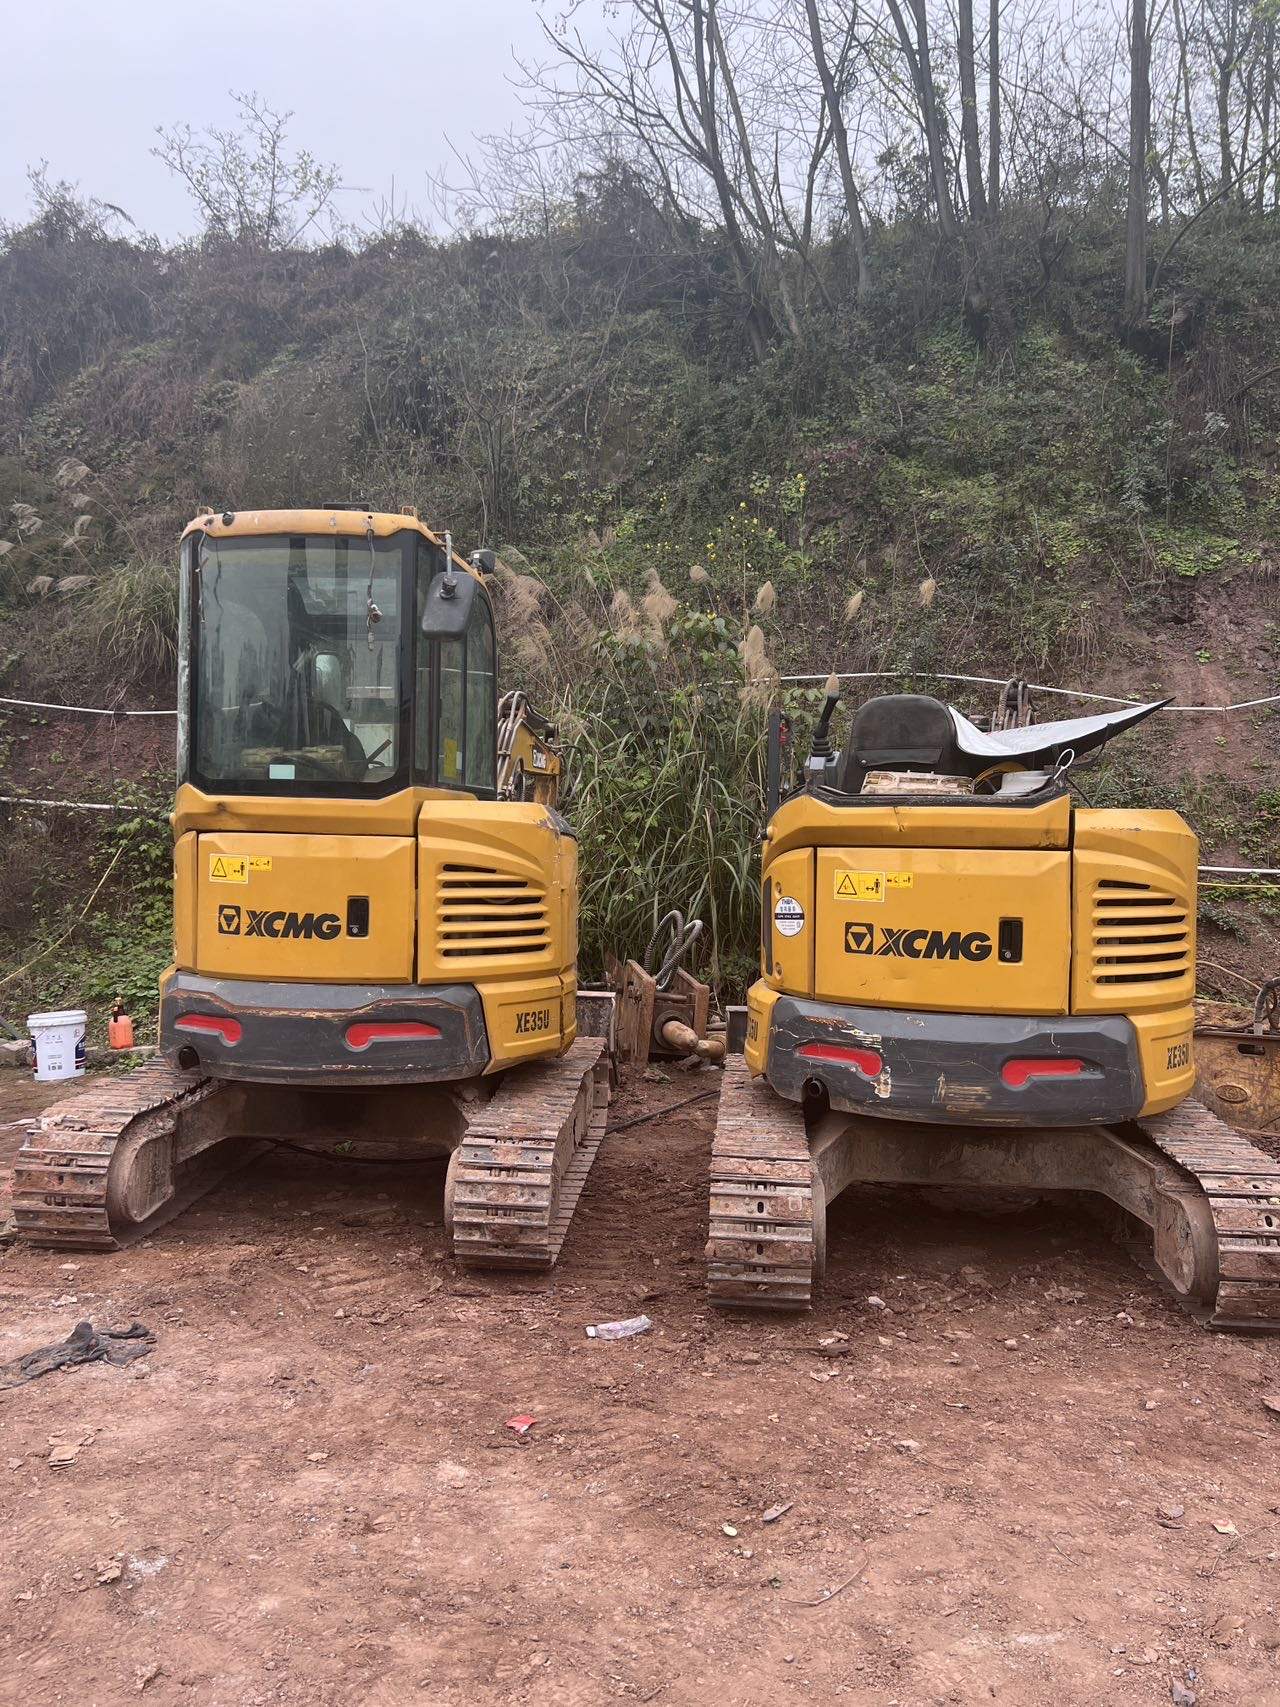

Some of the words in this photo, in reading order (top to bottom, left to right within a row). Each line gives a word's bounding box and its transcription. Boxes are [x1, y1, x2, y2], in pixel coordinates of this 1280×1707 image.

[244, 909, 342, 940] XCMG
[873, 927, 993, 962] XCMG
[515, 1009, 550, 1034] XE35U
